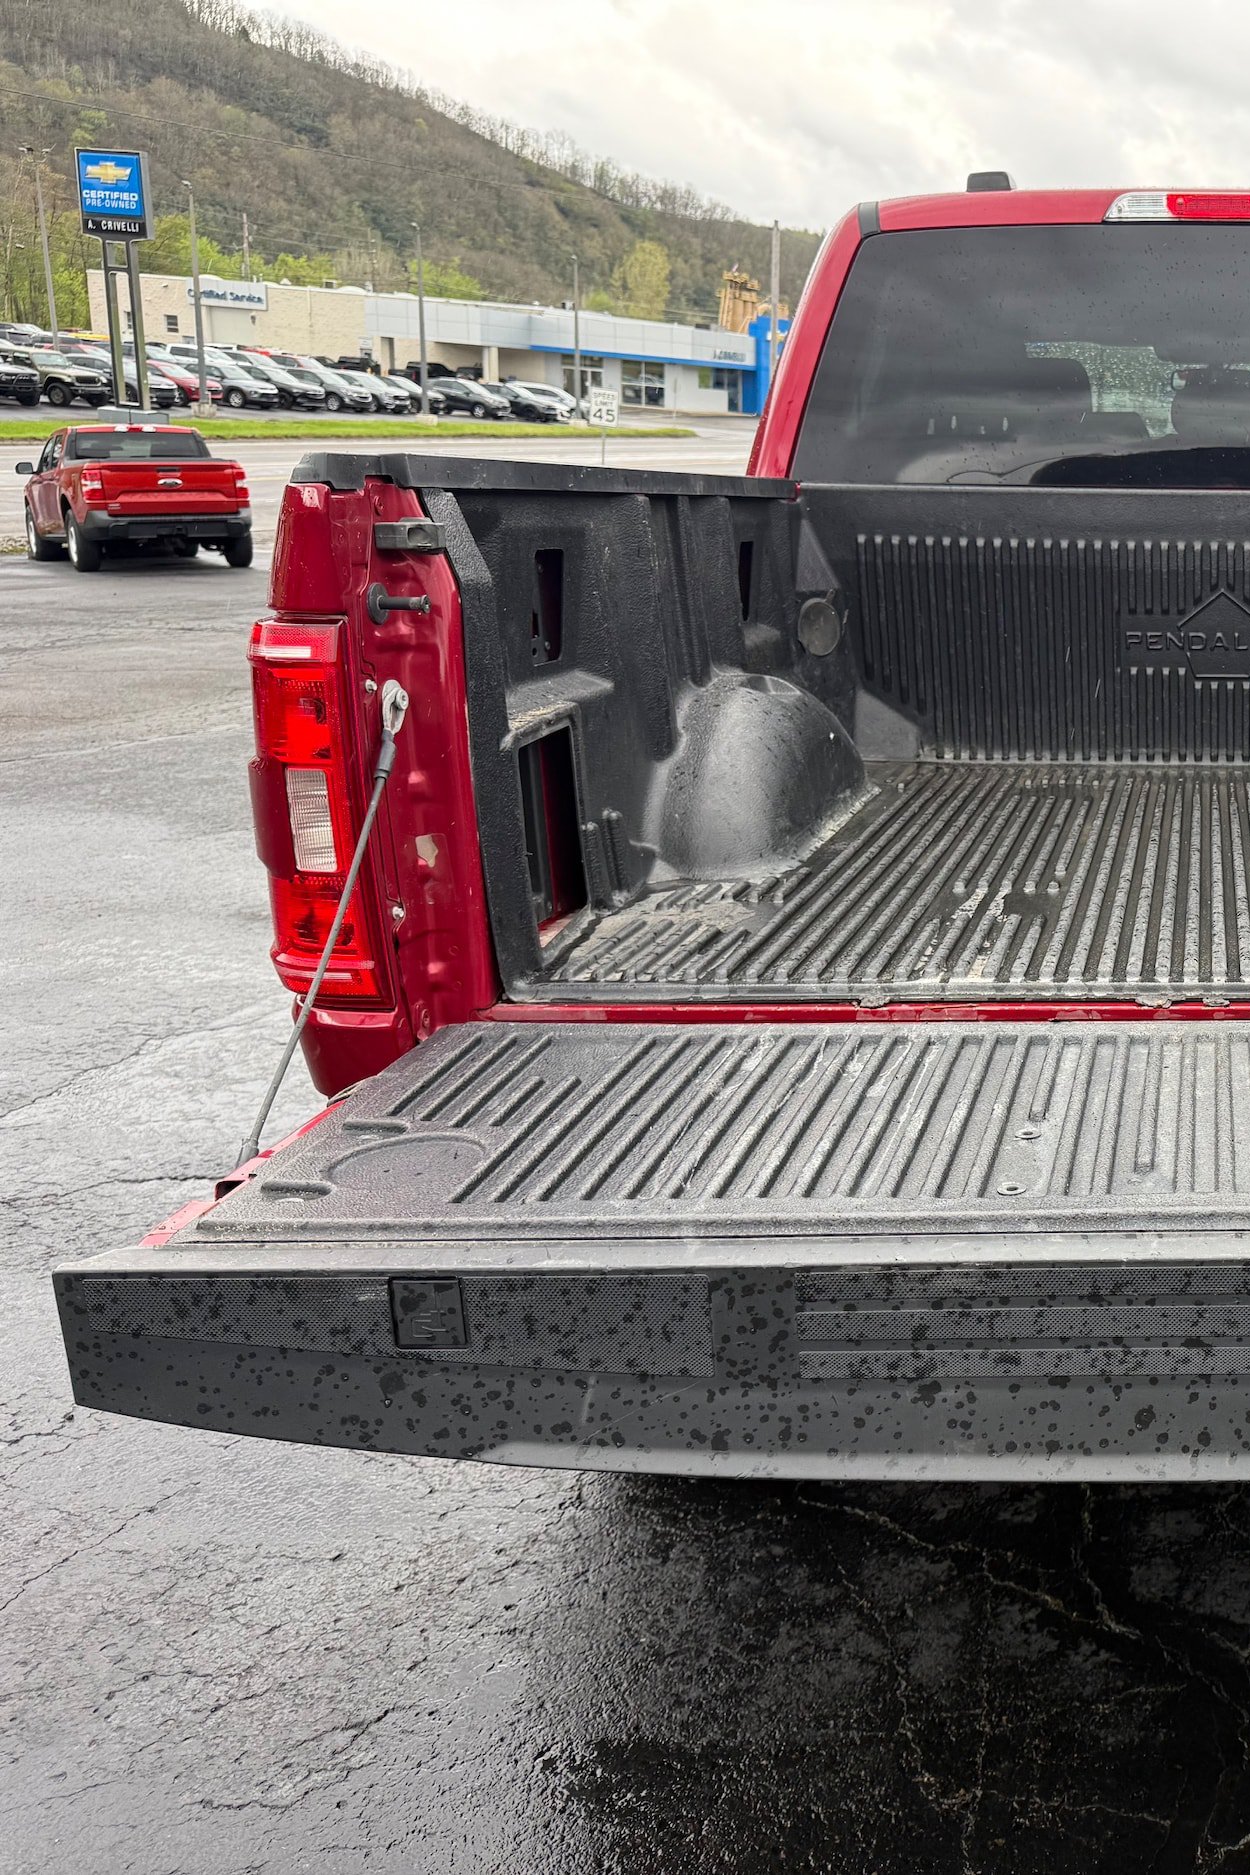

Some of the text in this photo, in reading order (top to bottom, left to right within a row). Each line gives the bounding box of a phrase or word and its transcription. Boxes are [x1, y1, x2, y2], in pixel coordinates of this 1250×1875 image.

[83, 189, 138, 201] CERTIFIED
[86, 198, 136, 210] PRE-OWNED
[87, 219, 139, 232] A. CRIVELLI
[593, 408, 616, 422] 45
